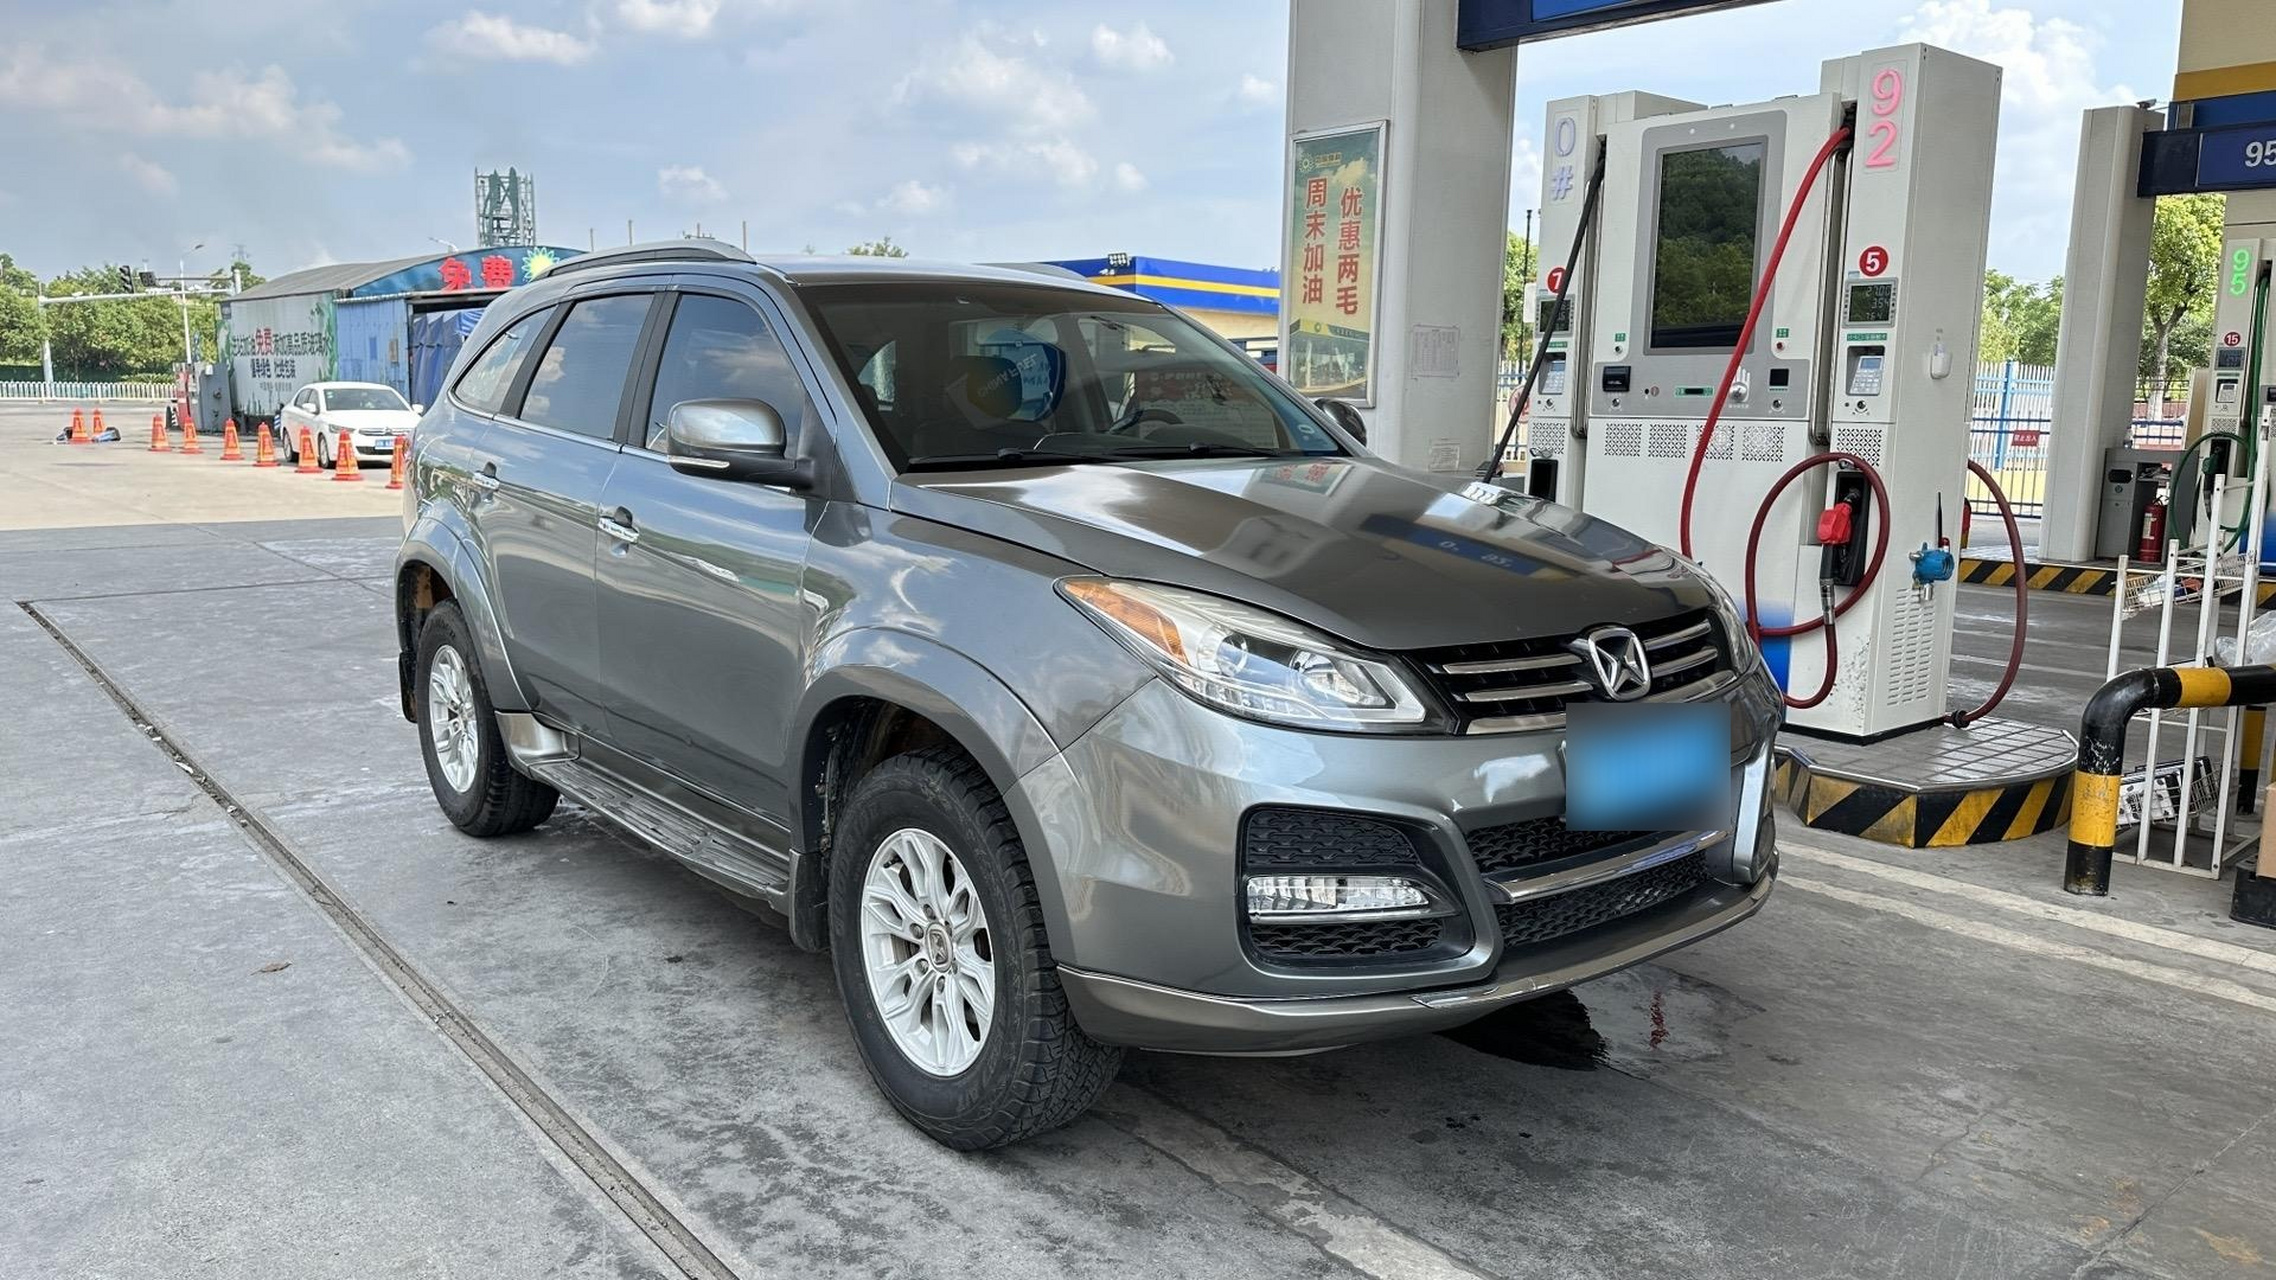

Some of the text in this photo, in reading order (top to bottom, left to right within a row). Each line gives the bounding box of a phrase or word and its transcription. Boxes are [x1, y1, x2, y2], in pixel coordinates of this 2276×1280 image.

[1866, 68, 1903, 168] 92
[438, 254, 514, 292] 免费
[1302, 177, 1328, 304] 周末加油
[1335, 187, 1363, 315] 优惠两毛
[2229, 248, 2250, 296] 95
